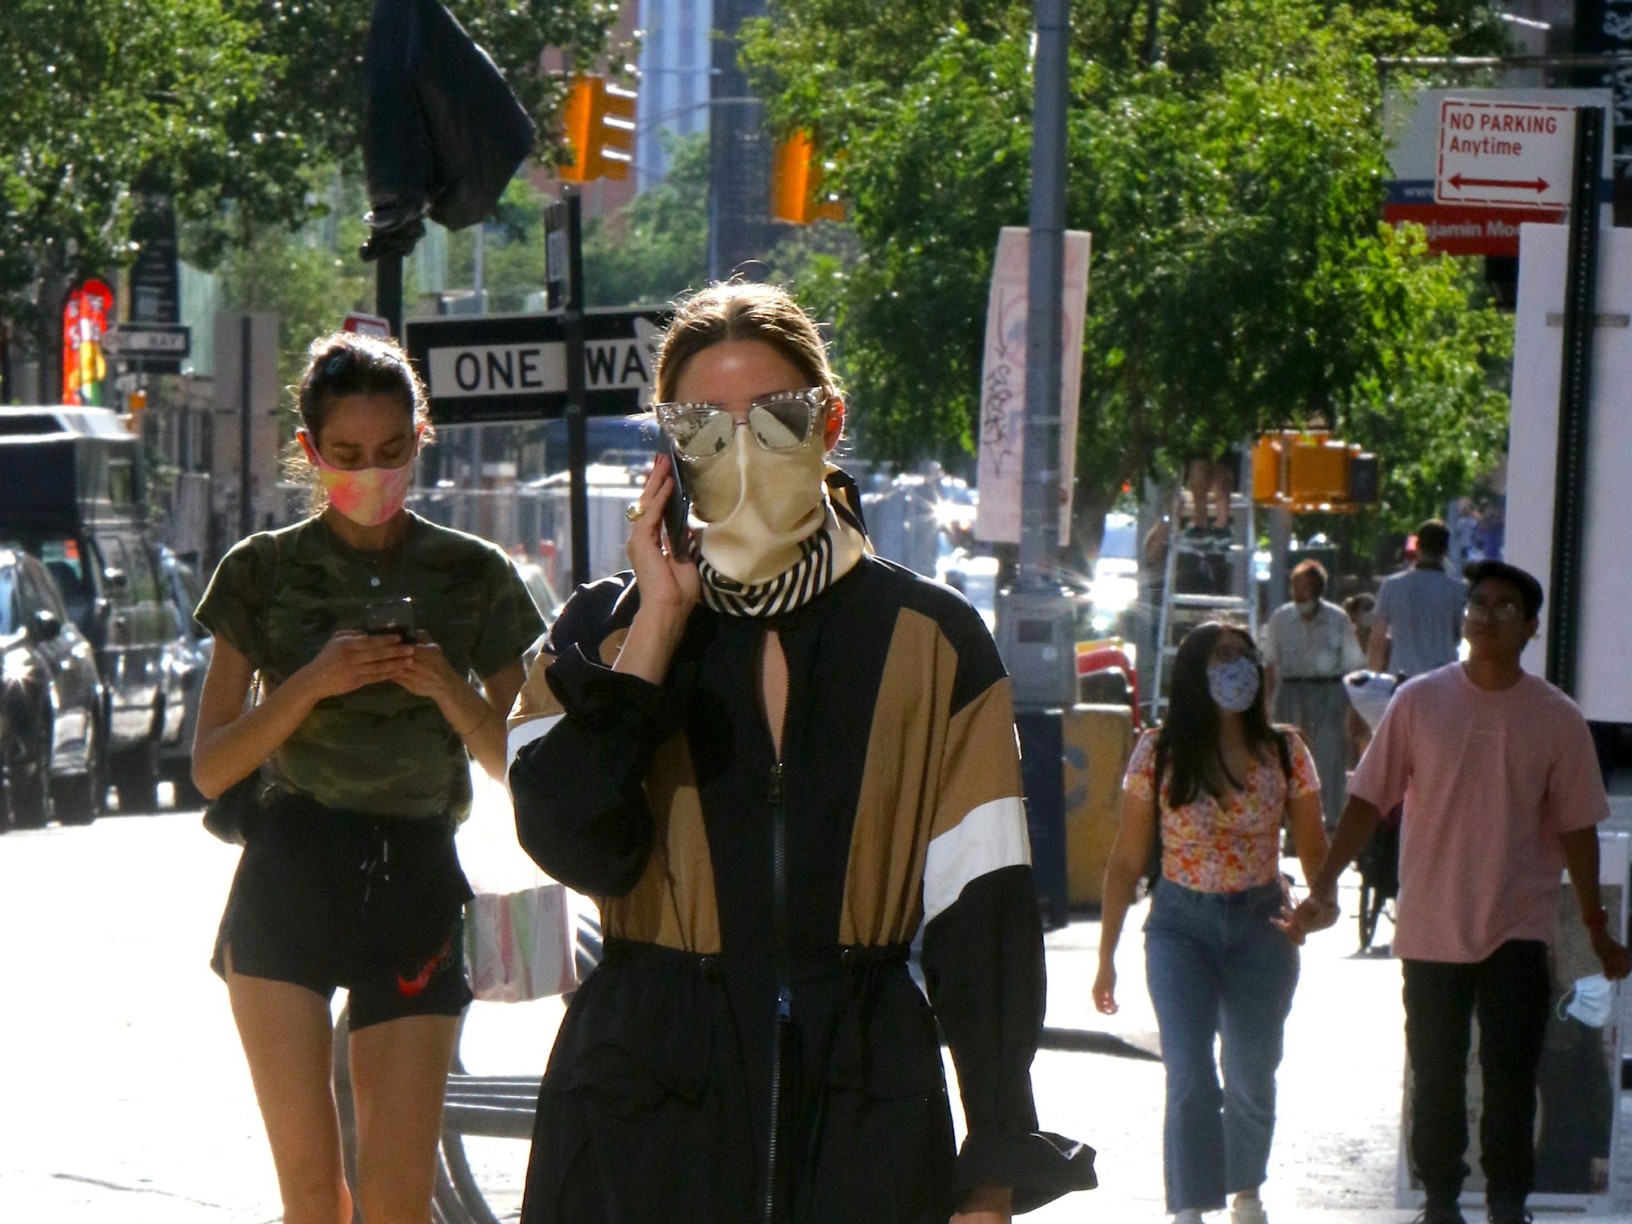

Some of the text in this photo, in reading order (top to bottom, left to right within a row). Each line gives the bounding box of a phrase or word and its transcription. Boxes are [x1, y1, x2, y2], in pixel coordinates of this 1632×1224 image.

[1449, 112, 1558, 134] NO PARKING
[1449, 136, 1523, 157] Anytime
[455, 344, 657, 392] ONE WA
